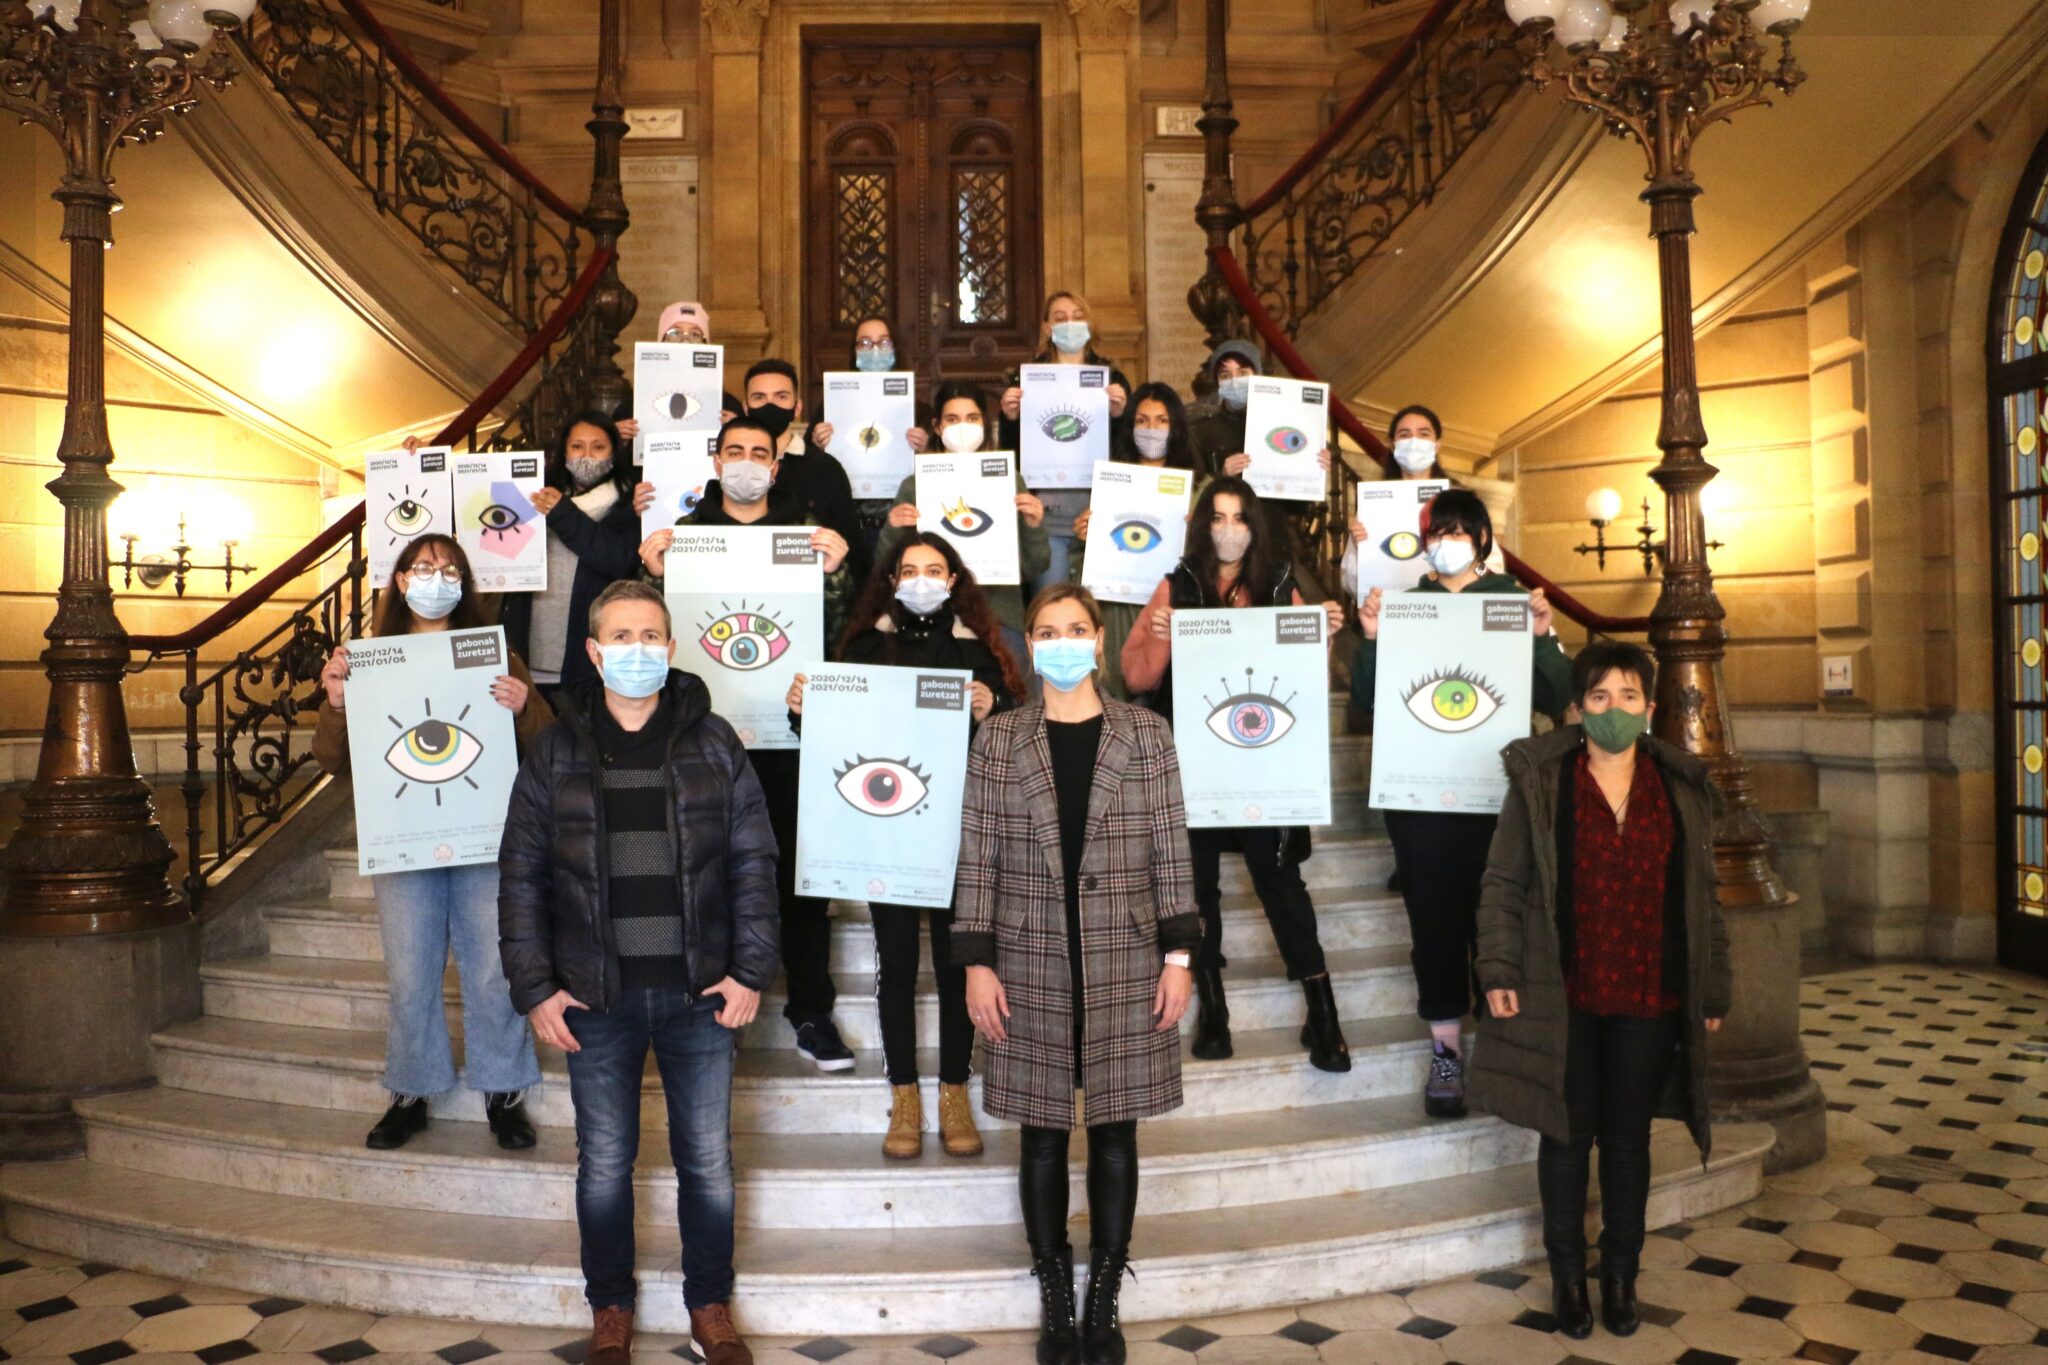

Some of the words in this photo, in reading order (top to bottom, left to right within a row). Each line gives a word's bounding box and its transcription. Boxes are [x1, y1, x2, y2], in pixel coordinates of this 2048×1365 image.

[671, 536, 726, 545] 2020/12/14
[671, 545, 728, 553] 2021/01/06
[1385, 603, 1437, 611] 2020/12/14
[1486, 604, 1524, 614] gabonak
[1385, 611, 1439, 619] 2021/01/06
[1486, 614, 1524, 622] zuretzat
[1177, 619, 1230, 627] 2020/12/14
[1279, 617, 1316, 626] gabonak
[1177, 627, 1232, 636] 2021/01/06
[1279, 626, 1316, 634] zuretzat
[456, 637, 495, 649] gabonak
[347, 647, 403, 660] 2020/12/14
[457, 647, 496, 658] zuretzat
[348, 655, 406, 668] 2021/01/06
[810, 674, 867, 685] 2020/12/14
[810, 683, 869, 693] 2021/01/06
[920, 679, 960, 690] gabonak
[920, 690, 960, 700] zuretzat
